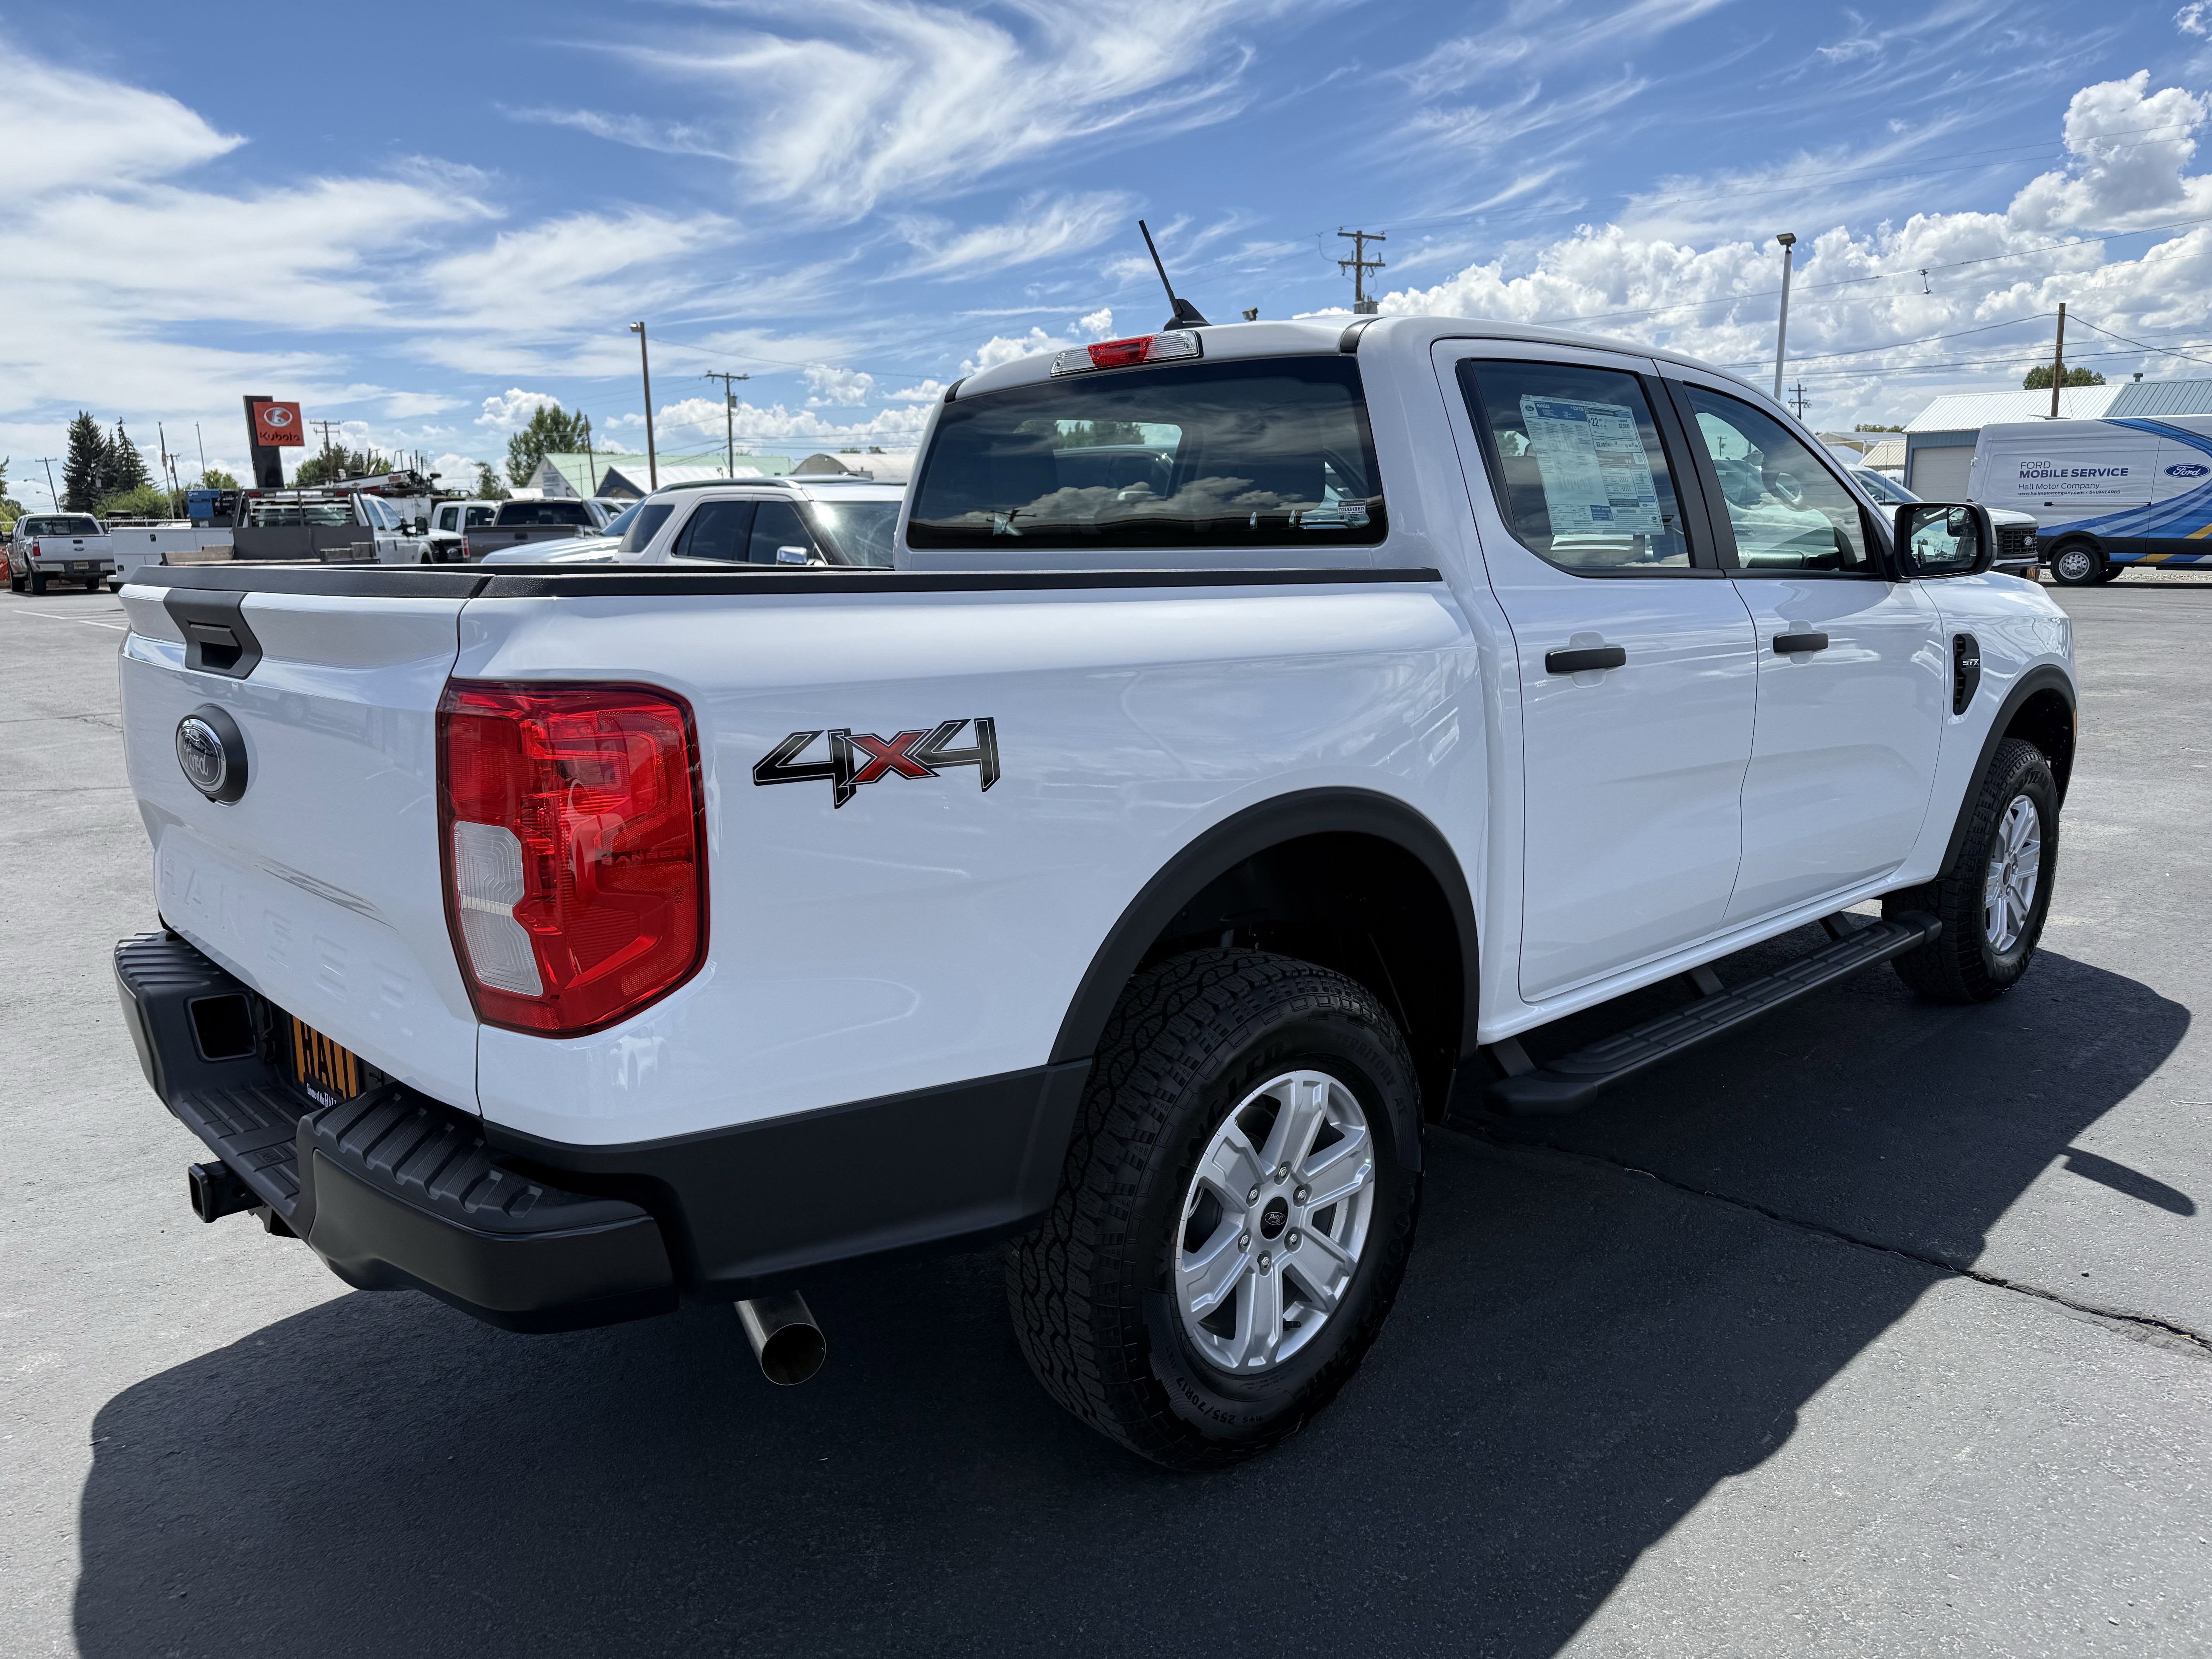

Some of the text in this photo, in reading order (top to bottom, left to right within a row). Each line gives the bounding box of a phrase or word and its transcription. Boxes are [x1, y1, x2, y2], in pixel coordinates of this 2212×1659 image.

[260, 431, 300, 441] Kubota
[2020, 461, 2051, 469] FORD
[2019, 468, 2129, 478] MOBILE SERVICE
[2173, 465, 2202, 476] Ford
[1176, 1377, 1237, 1425] 255/70R17
